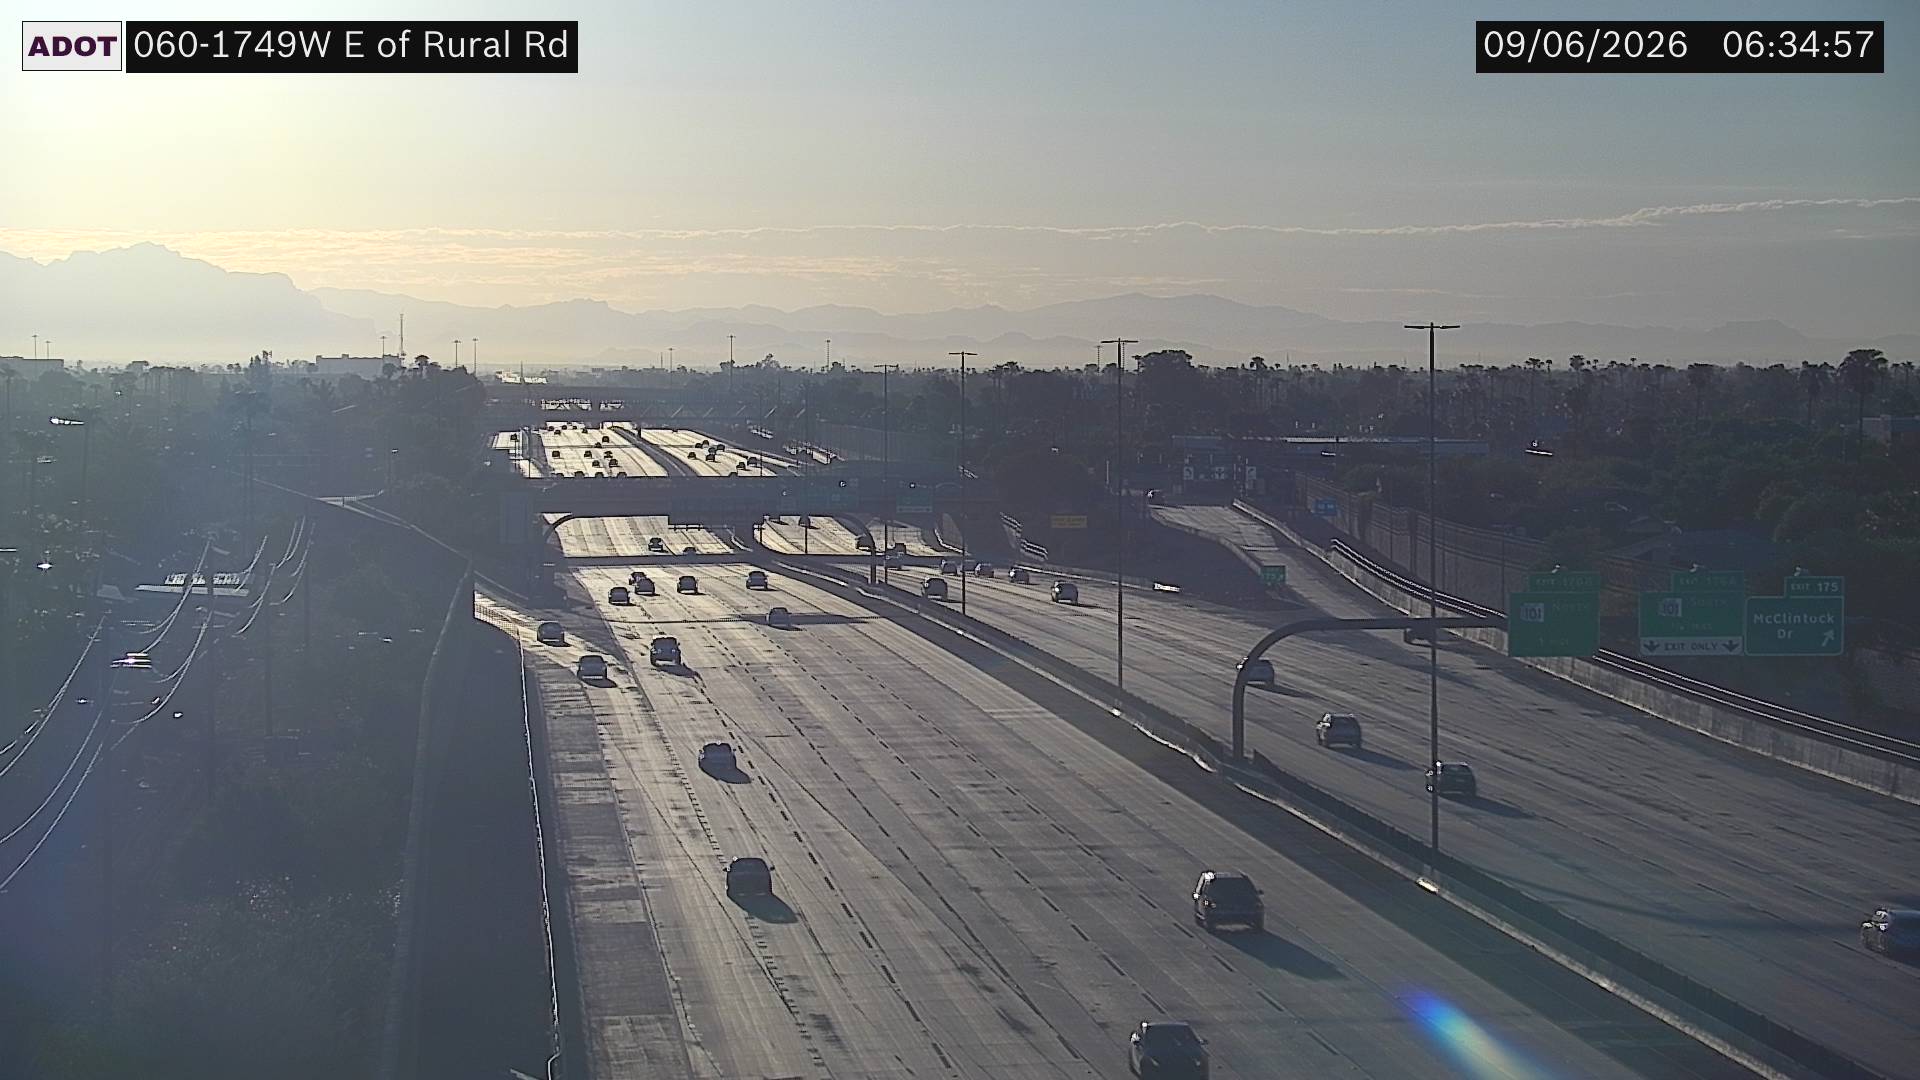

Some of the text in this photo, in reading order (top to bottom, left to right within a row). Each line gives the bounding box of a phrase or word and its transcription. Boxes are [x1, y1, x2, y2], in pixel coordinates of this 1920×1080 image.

[1817, 582, 1839, 592] 175
[1524, 607, 1541, 619] 101
[1663, 603, 1679, 615] 101
[1753, 611, 1835, 624] McClintock
[1777, 628, 1793, 639] Dr
[1664, 642, 1718, 650] EXIT ONLY
